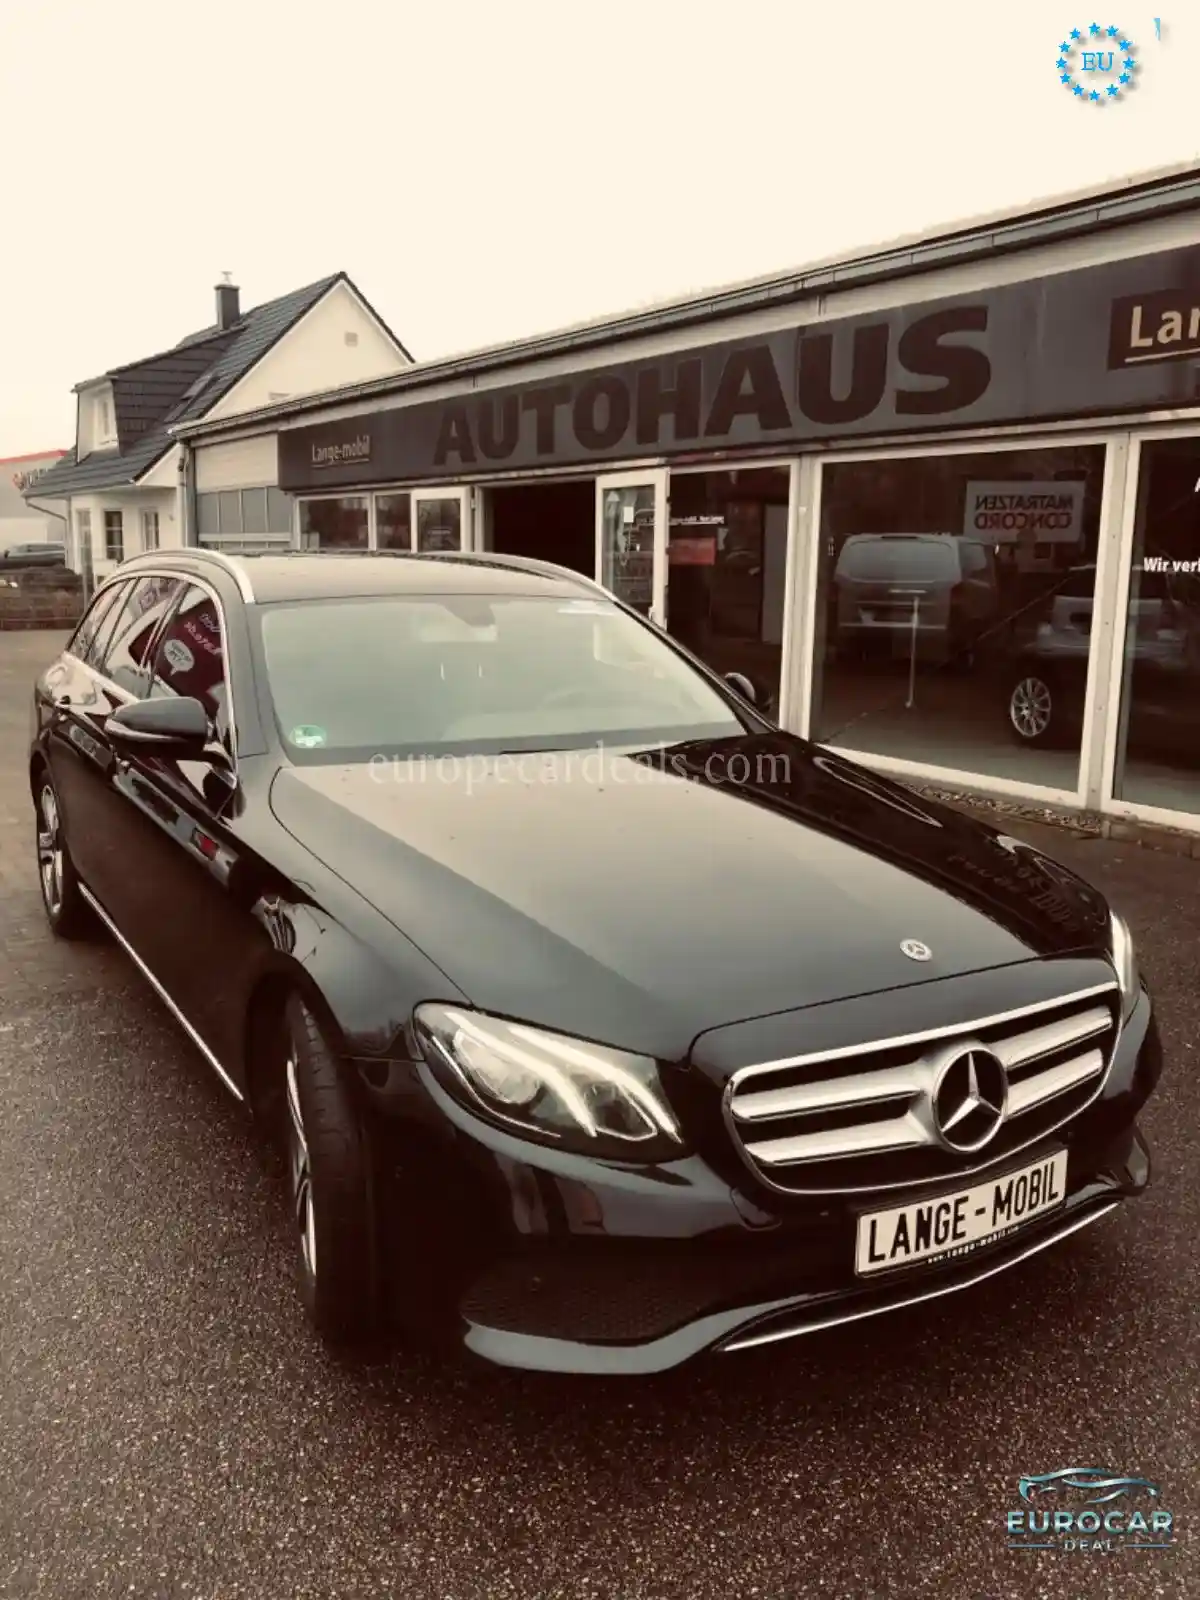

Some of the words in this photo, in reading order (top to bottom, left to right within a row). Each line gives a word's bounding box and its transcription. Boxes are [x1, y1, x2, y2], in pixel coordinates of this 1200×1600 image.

[433, 306, 992, 467] AUTOHAUS
[1143, 557, 1169, 572] Wir
[1172, 558, 1200, 573] ver
